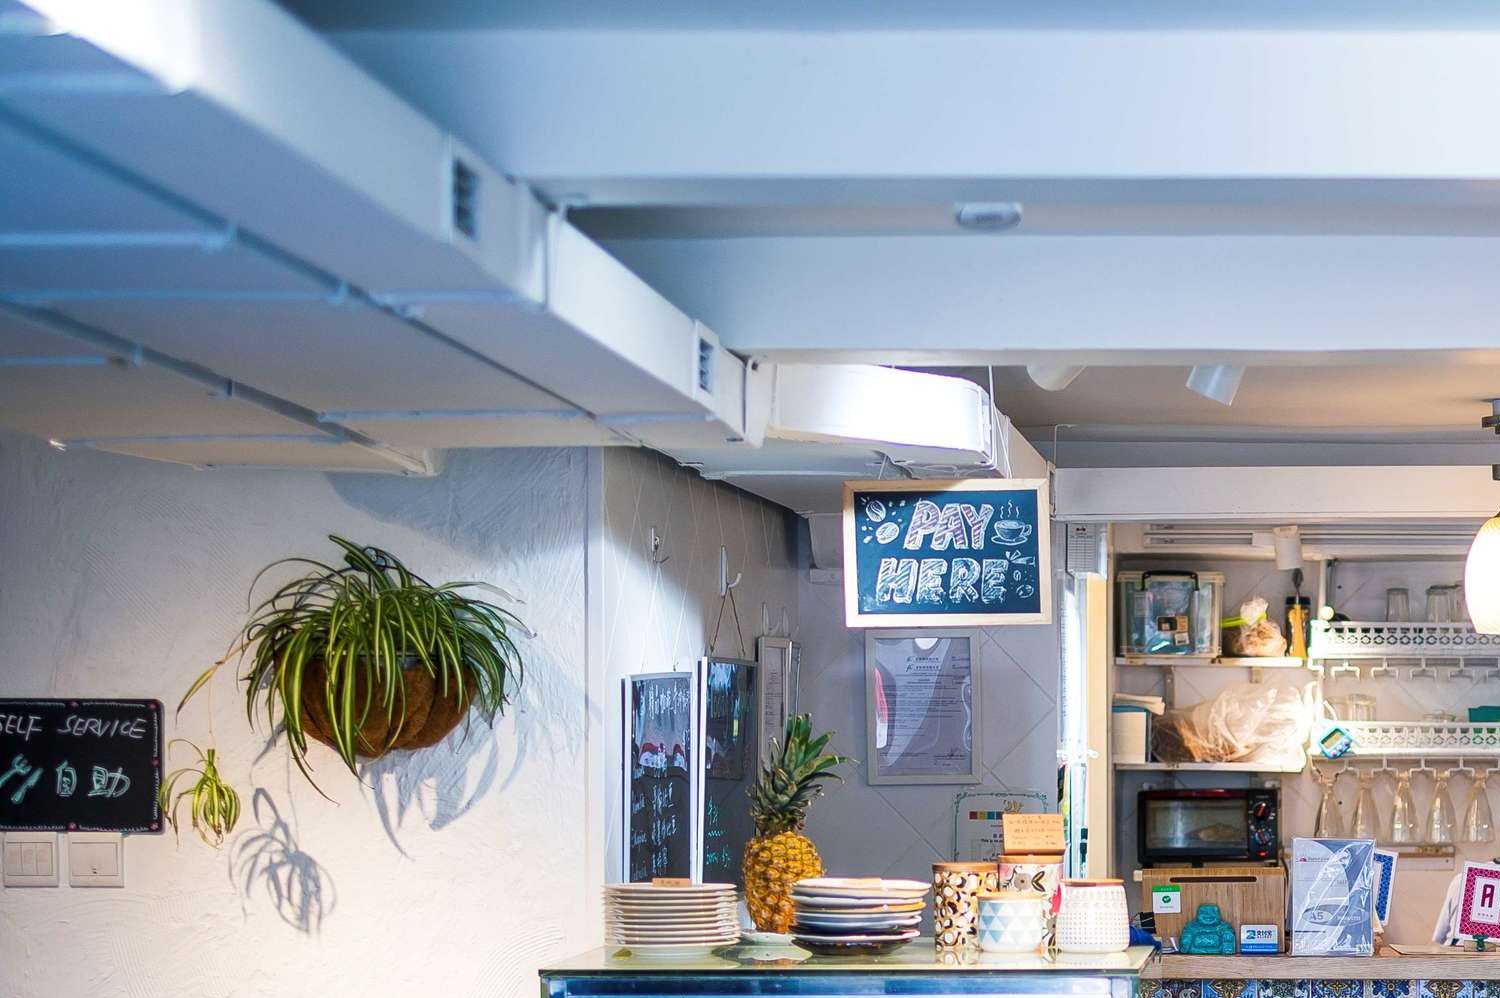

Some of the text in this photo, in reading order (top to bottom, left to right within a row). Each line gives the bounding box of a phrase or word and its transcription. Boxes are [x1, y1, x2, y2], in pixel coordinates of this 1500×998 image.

[903, 500, 994, 550] PAY
[876, 557, 1009, 604] HERE
[57, 714, 148, 739] SERVICE
[55, 760, 131, 798] 自助
[1480, 884, 1495, 909] A
